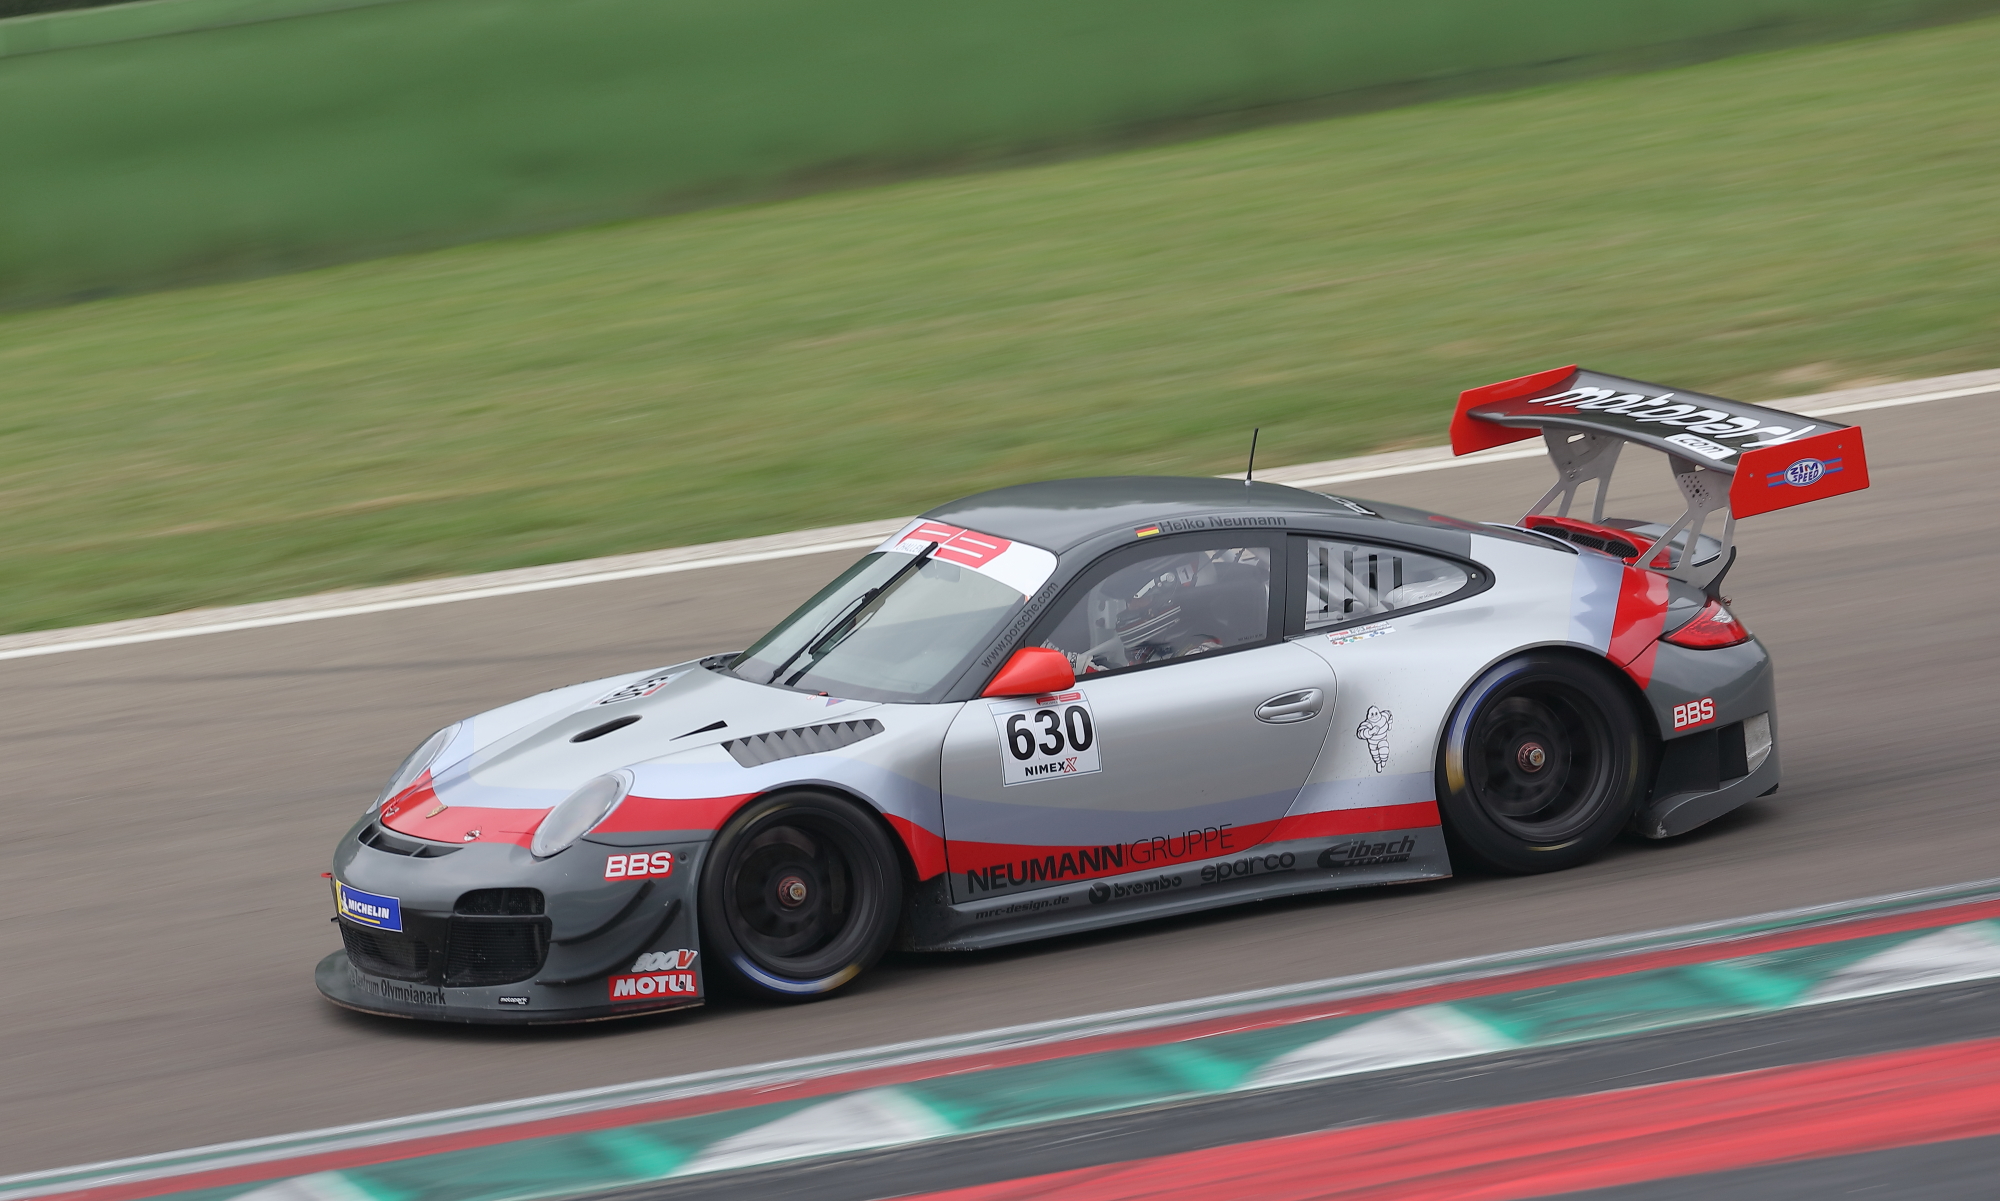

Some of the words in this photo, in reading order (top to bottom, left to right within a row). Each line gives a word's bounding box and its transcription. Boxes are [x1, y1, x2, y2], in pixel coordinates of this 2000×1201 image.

[1792, 469, 1820, 484] SPEED
[1158, 519, 1206, 533] Heiko
[1208, 514, 1288, 528] Neumann
[981, 581, 1060, 668] www.porsche.com
[1673, 698, 1714, 728] BBS
[1006, 705, 1093, 761] 630
[604, 851, 672, 878] BBS
[1317, 835, 1416, 868] Eibach
[1200, 851, 1296, 883] sparco
[1114, 875, 1183, 898] brembo
[348, 898, 390, 919] MICHELIN
[975, 895, 1070, 919] mrc-design.de
[381, 978, 447, 1006] Olympiapark
[613, 974, 695, 997] MOTUL
